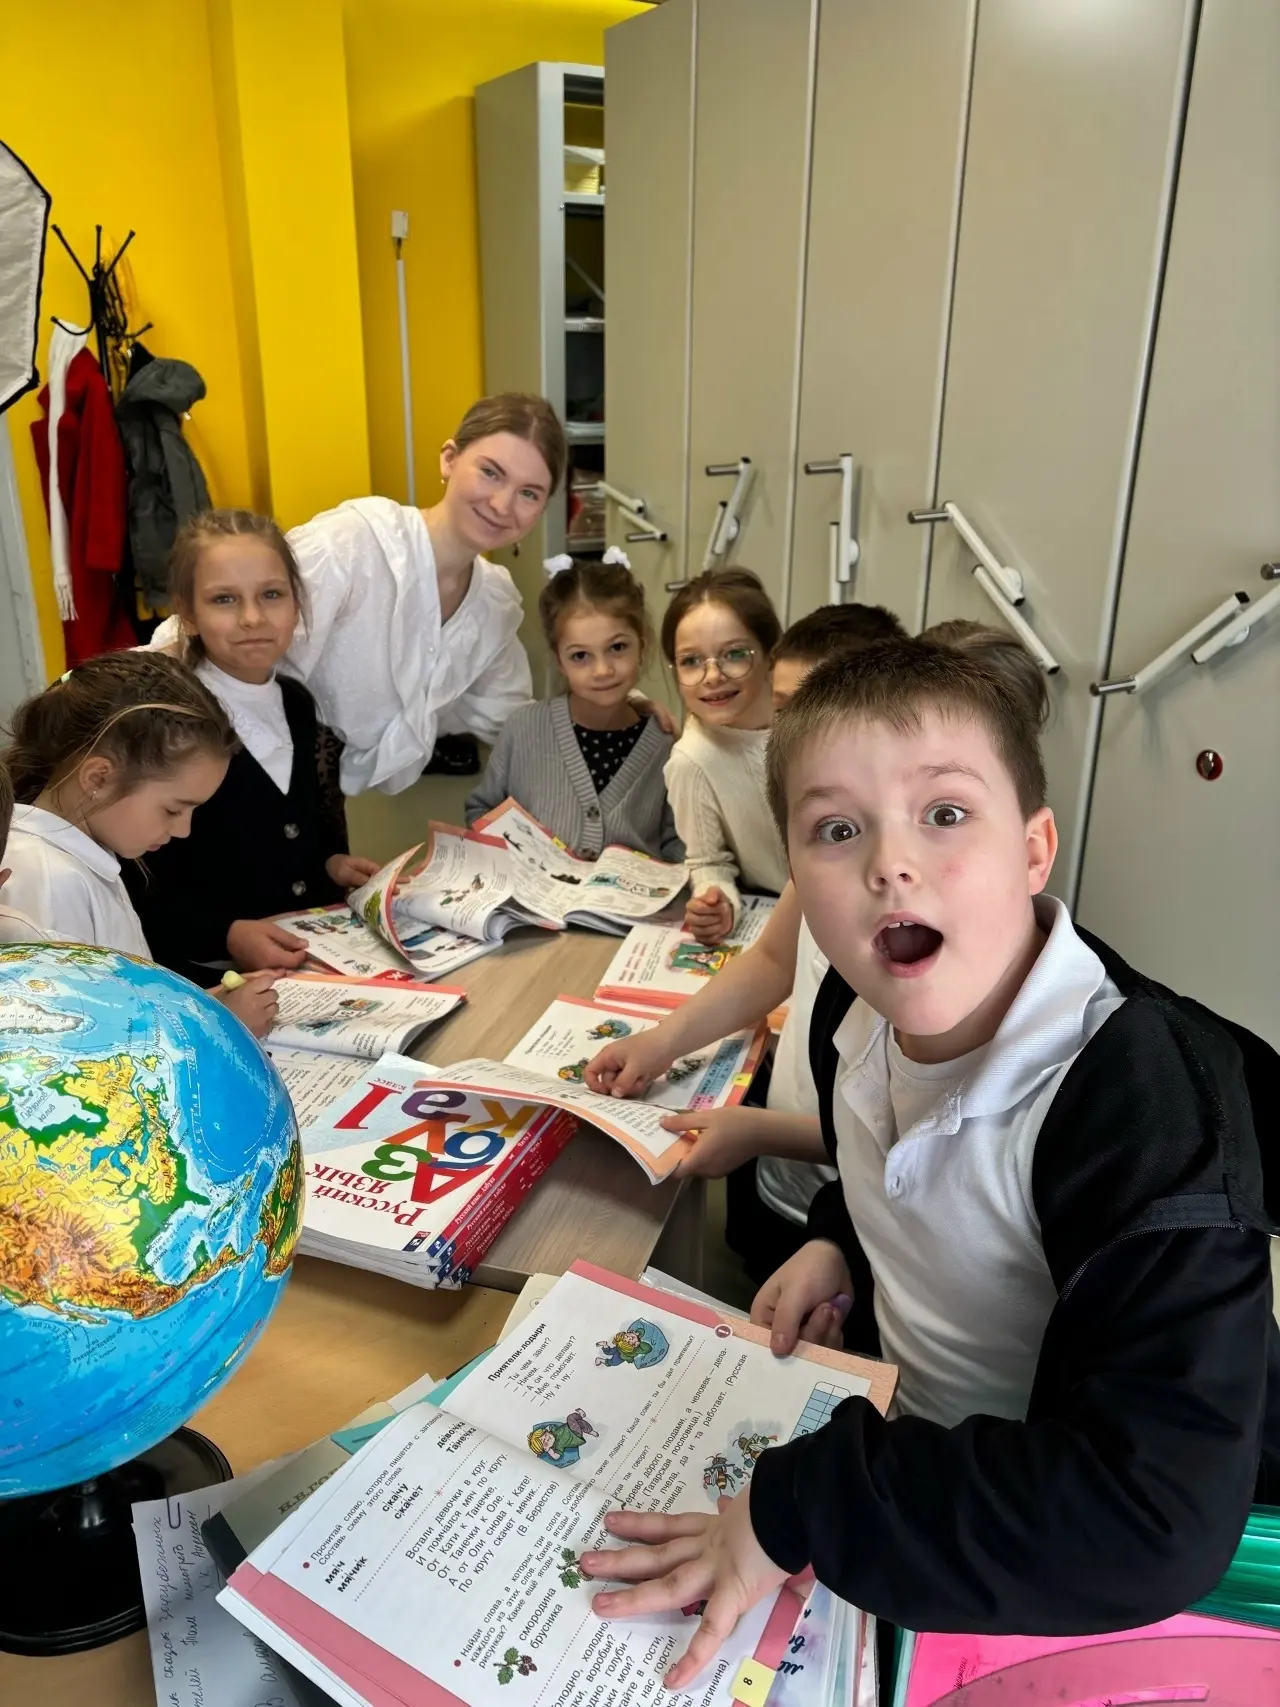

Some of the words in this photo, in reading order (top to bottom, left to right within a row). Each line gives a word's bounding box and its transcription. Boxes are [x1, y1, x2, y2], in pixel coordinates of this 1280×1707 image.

[334, 1081, 400, 1131] 1
[373, 1076, 407, 1091] класс
[313, 1184, 428, 1228] Русский
[486, 1322, 547, 1382] Приятели-лодыри
[542, 1362, 555, 1373] что
[533, 1381, 550, 1396] Мне
[309, 1523, 343, 1561] Прочитай
[342, 1499, 365, 1522] слово,
[364, 1469, 389, 1497] которое
[317, 1534, 347, 1566] Составь
[346, 1508, 367, 1532] схему
[365, 1487, 384, 1508] этого
[383, 1466, 403, 1487] слова.
[404, 1526, 435, 1560] Встали
[434, 1488, 464, 1526] девочки
[462, 1478, 472, 1486] в
[470, 1458, 488, 1477] круг.
[414, 1555, 427, 1566] И
[461, 1489, 477, 1508] мяч
[476, 1475, 488, 1488] по
[487, 1453, 508, 1474] кругу.
[515, 1523, 530, 1537] (В.
[524, 1480, 560, 1523] Берестов)
[625, 1480, 644, 1506] ерево
[425, 1557, 440, 1572] От
[438, 1532, 460, 1555] Кати
[459, 1522, 468, 1530] к
[464, 1486, 498, 1519] Танечке,
[436, 1563, 451, 1579] От
[448, 1525, 481, 1560] Танечки
[479, 1515, 489, 1523] к
[485, 1494, 505, 1513] Оле.
[447, 1577, 459, 1587] А
[457, 1560, 469, 1574] от
[467, 1538, 486, 1558] Оли
[485, 1509, 508, 1536] снова
[505, 1499, 515, 1507] к
[511, 1474, 532, 1498] Кате!
[457, 1577, 473, 1593] По
[472, 1548, 495, 1575] кругу
[492, 1516, 516, 1547] скачет
[515, 1483, 542, 1515] мячик...
[581, 1498, 613, 1546] земляника
[459, 1627, 483, 1657] Найди
[482, 1598, 505, 1624] слова,
[510, 1551, 534, 1583] которых
[533, 1534, 546, 1549] три
[544, 1510, 563, 1532] слога.
[469, 1626, 496, 1663] каждого
[505, 1588, 521, 1608] этих
[519, 1567, 537, 1586] слов.
[534, 1540, 553, 1563] Какие
[552, 1514, 570, 1538] ягоды
[477, 1623, 508, 1670] рисунках?
[505, 1598, 526, 1623] Какие
[524, 1579, 538, 1597] ещё
[536, 1555, 554, 1578] ягоды
[560, 1510, 581, 1542] знаешь?
[518, 1587, 557, 1641] смородина
[529, 1603, 564, 1649] брусника
[580, 1620, 612, 1663] холодно,
[585, 1633, 616, 1683] воробьи?
[604, 1641, 628, 1677] голуби
[640, 1677, 656, 1699] нас
[653, 1634, 678, 1675] горсти!
[642, 1635, 665, 1666] гости,
[616, 1654, 635, 1684] мои?
[743, 1677, 754, 1686] 8
